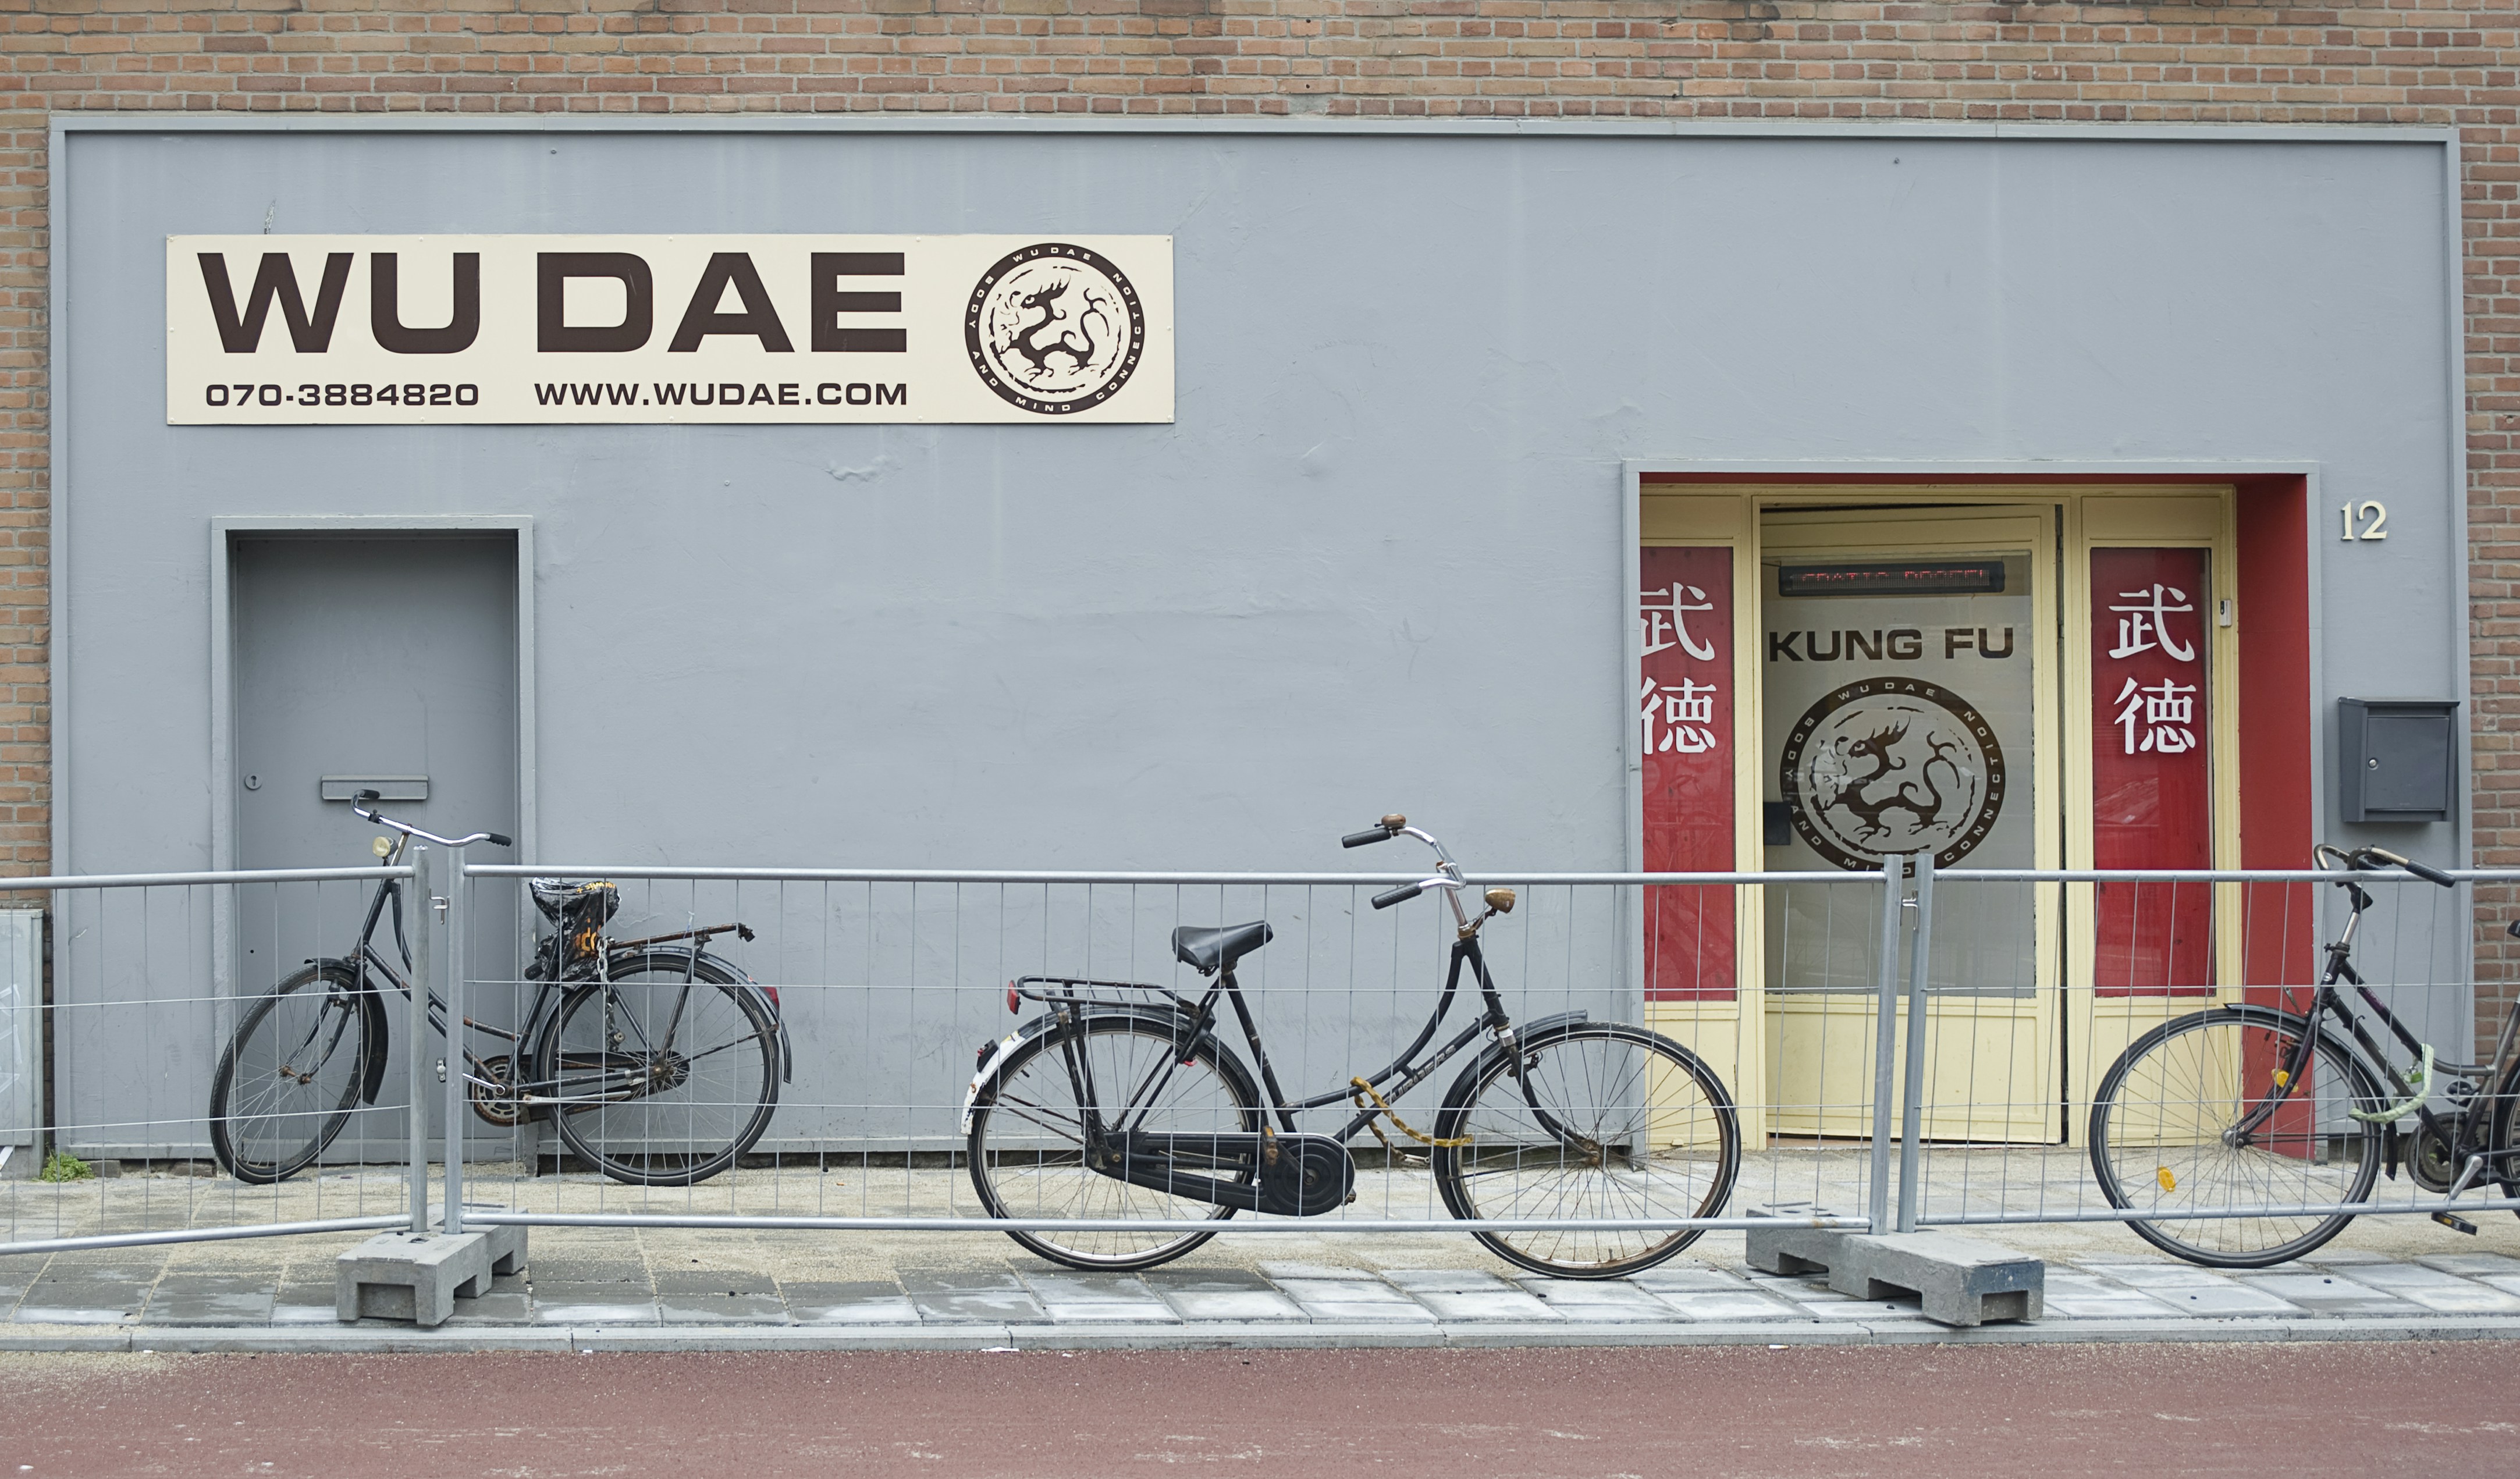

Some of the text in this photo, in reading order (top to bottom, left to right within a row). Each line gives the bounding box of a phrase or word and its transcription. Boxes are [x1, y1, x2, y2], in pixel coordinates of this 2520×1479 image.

[1013, 247, 1091, 262] WU DAE
[197, 253, 907, 354] WU DAE
[969, 273, 1141, 411] BODY AND MIND CONNECTION
[206, 384, 478, 406] 070-3884820
[535, 383, 907, 405] WWW.WUDAE.COM
[2341, 500, 2387, 541] 12
[1769, 628, 2013, 662] KUNG FU
[1838, 682, 1935, 701] WU DAE
[1843, 858, 1911, 874] MID
